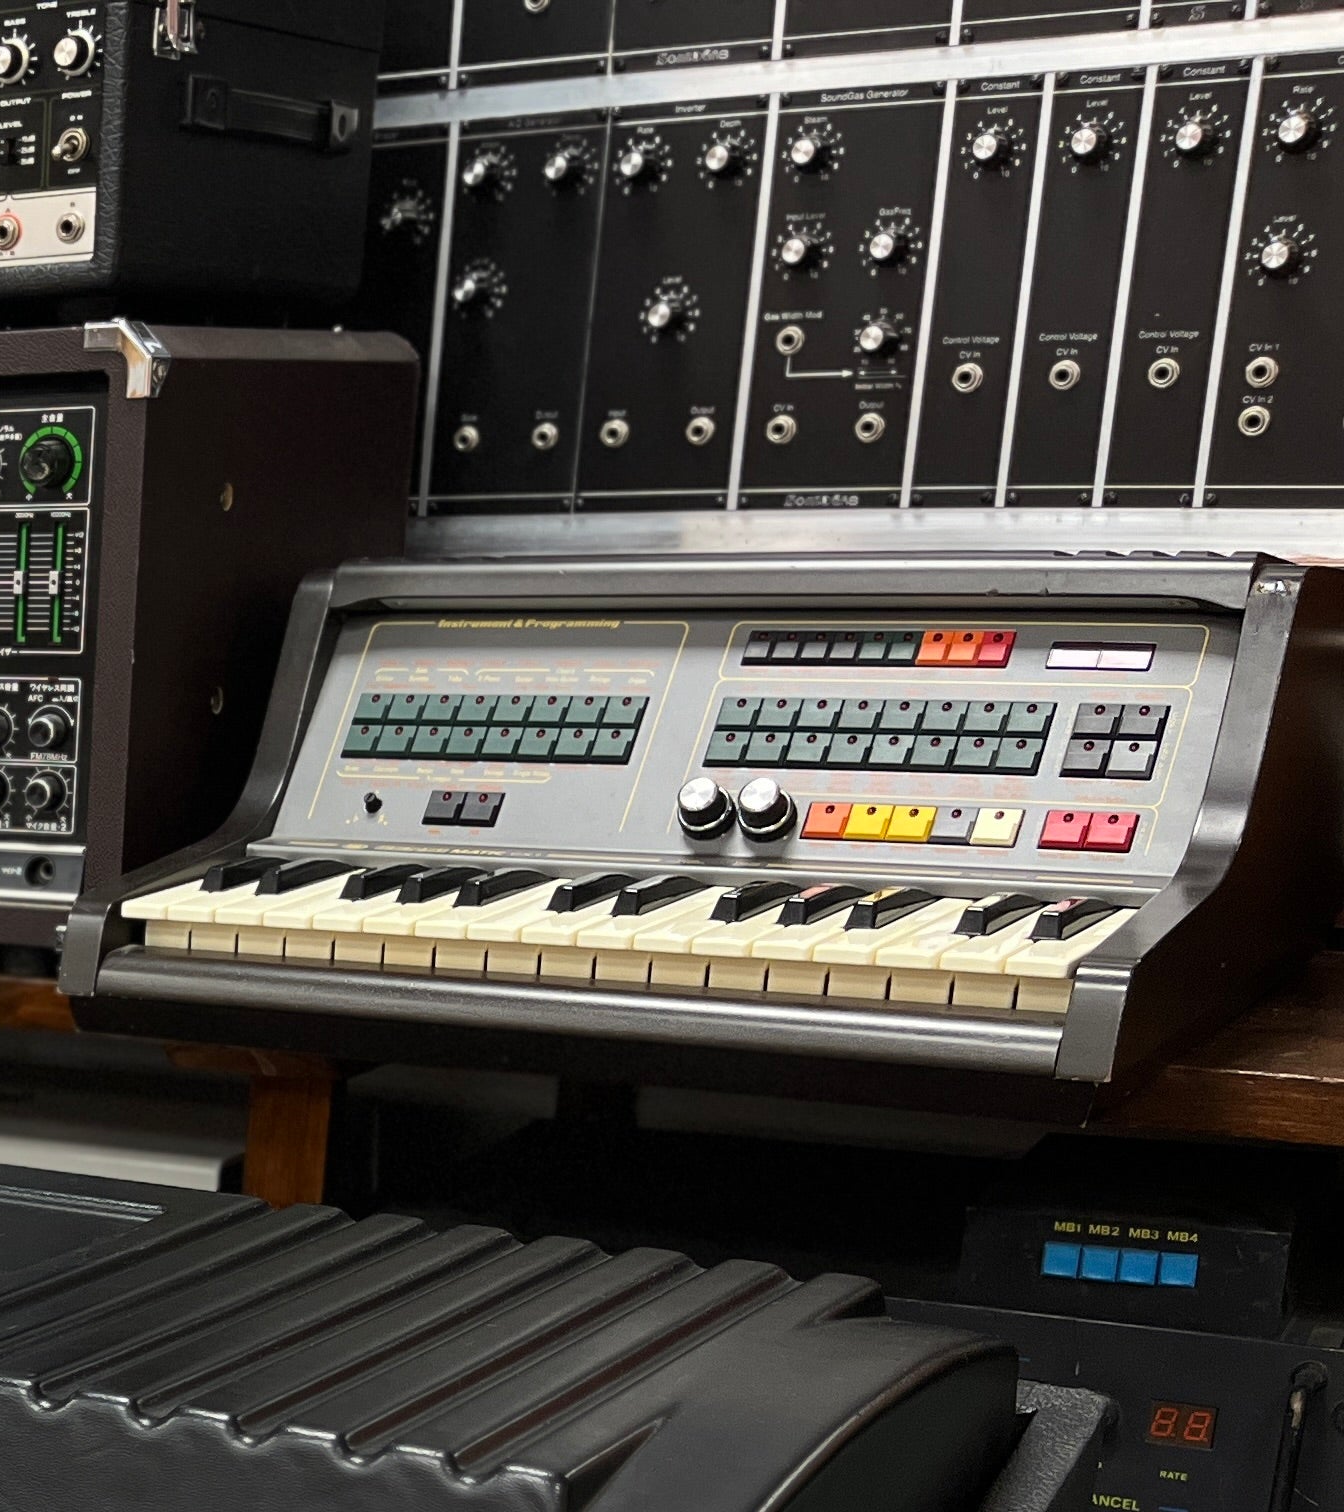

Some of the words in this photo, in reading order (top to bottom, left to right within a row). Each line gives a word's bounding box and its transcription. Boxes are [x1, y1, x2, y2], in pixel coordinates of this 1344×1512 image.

[1184, 66, 1226, 77] Constant
[1080, 73, 1121, 84] Constant
[981, 81, 1020, 91] Constant
[1292, 85, 1316, 93] Rate
[821, 92, 864, 102] SoundGas
[866, 89, 909, 99] Generator
[1189, 92, 1213, 100] Level
[1086, 100, 1109, 108] Level
[675, 104, 706, 113] Inverter
[987, 106, 1008, 114] Level
[1039, 333, 1067, 341] Control
[1069, 333, 1098, 341] Voltage
[1139, 331, 1167, 339] Control
[1170, 330, 1199, 339] Voltage
[943, 336, 970, 344] Control
[1057, 348, 1069, 356] CV
[1156, 346, 1169, 354] CV
[959, 351, 972, 359] CV
[1243, 395, 1256, 403] CV
[438, 619, 512, 628] Instrument
[525, 619, 621, 628] Programming
[1054, 1221, 1081, 1232] MB1
[1088, 1224, 1120, 1236] MB2
[1128, 1228, 1159, 1239] MB3
[1167, 1231, 1198, 1242] MB4
[1160, 1470, 1188, 1482] RATE
